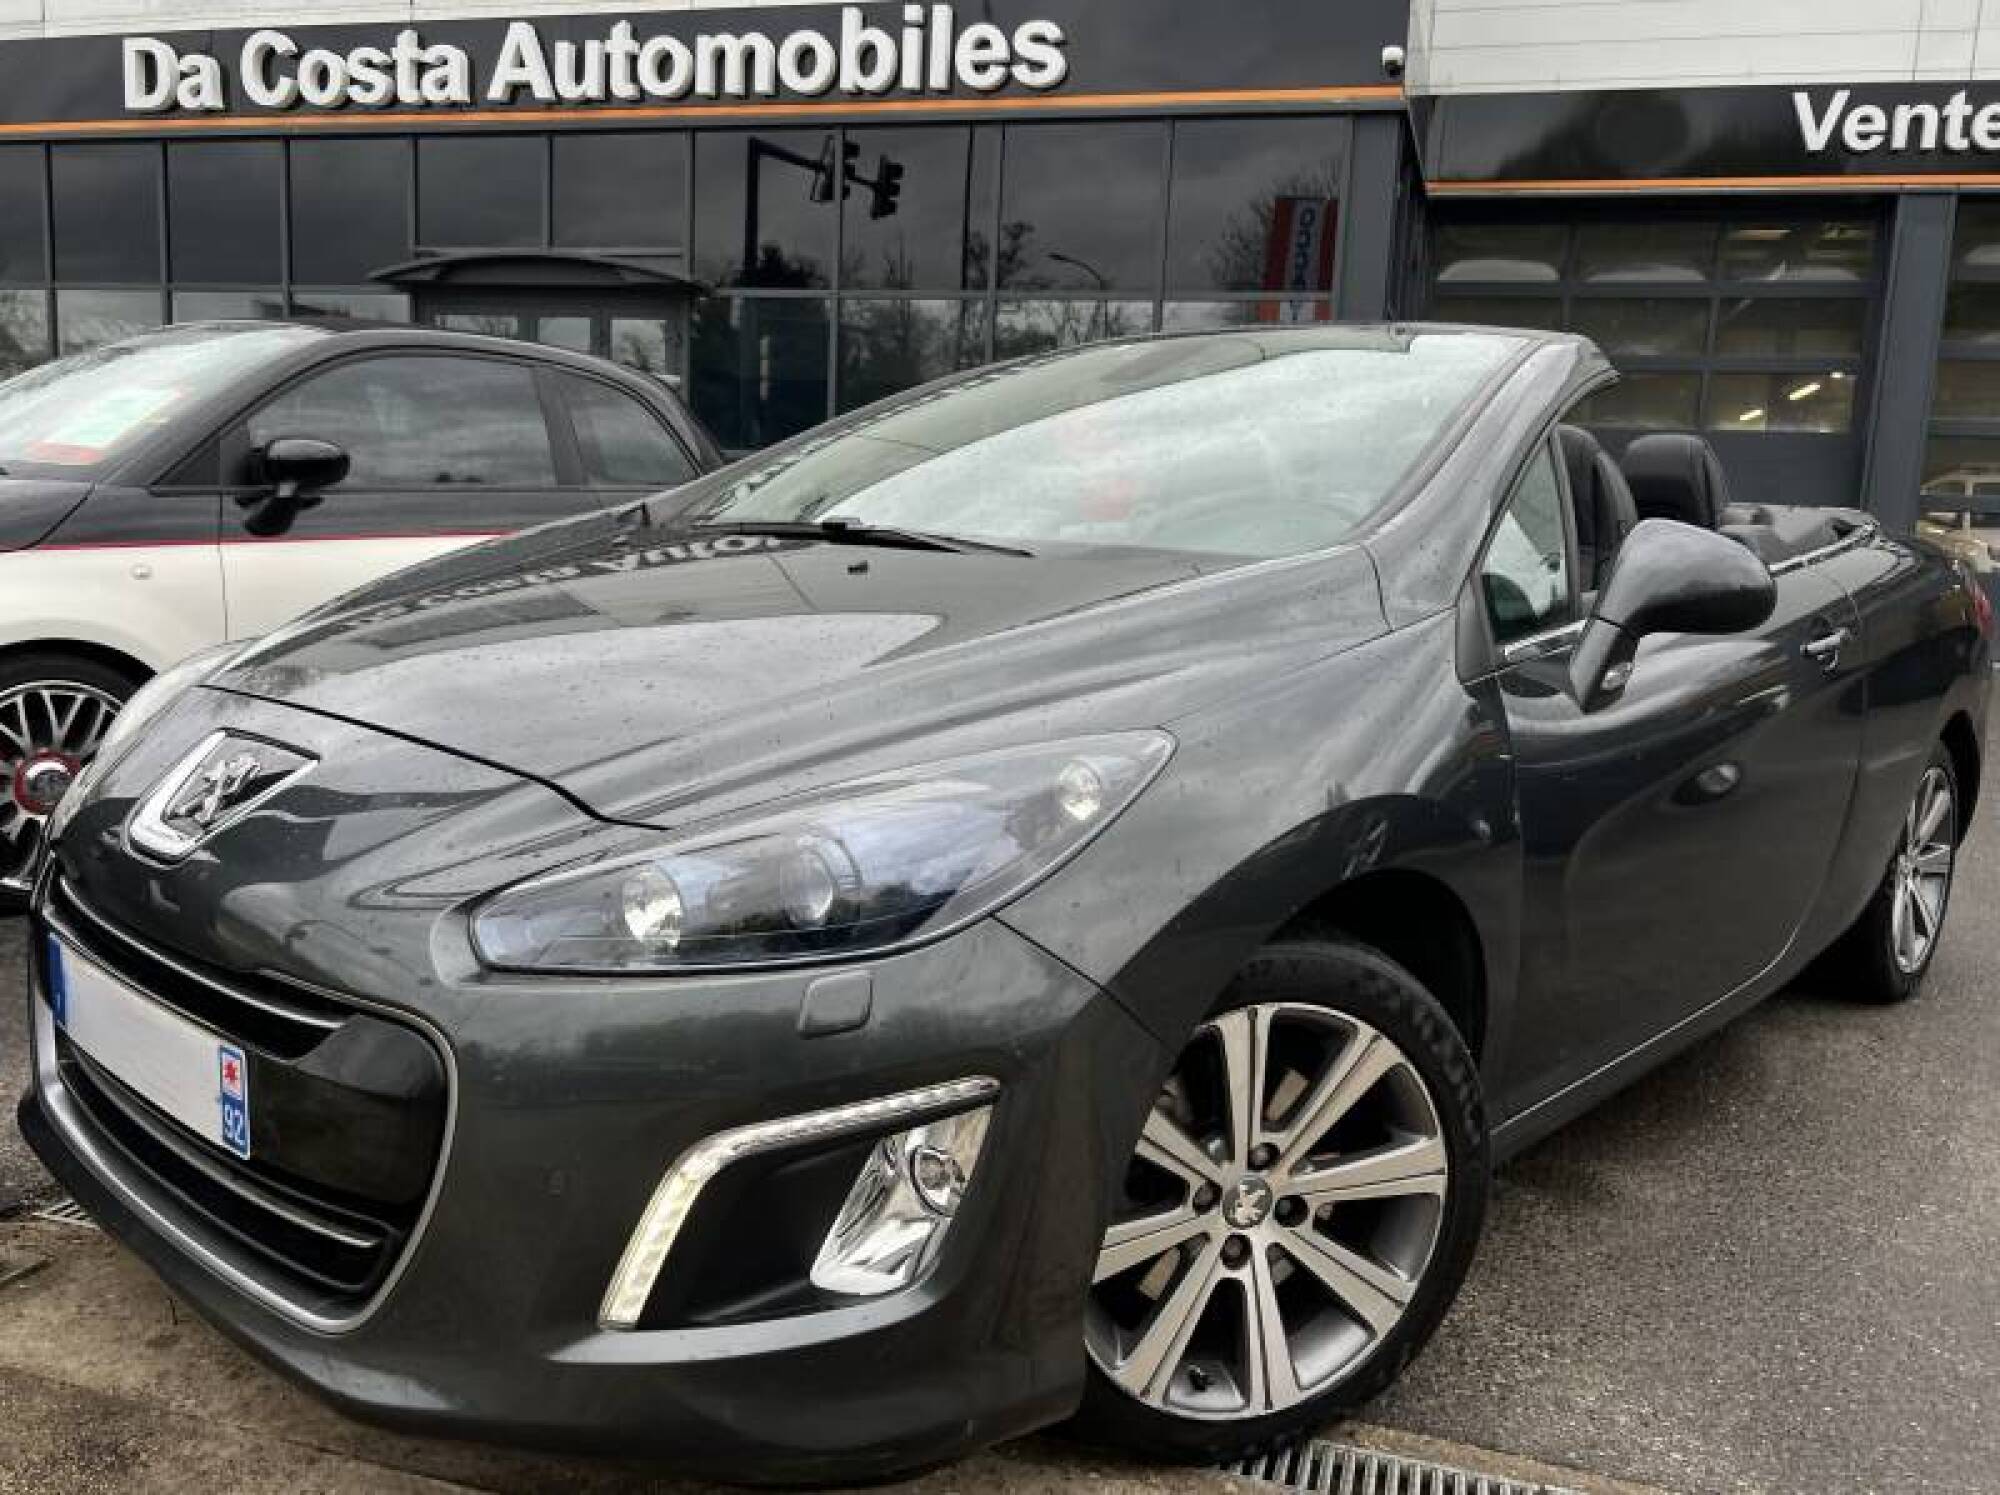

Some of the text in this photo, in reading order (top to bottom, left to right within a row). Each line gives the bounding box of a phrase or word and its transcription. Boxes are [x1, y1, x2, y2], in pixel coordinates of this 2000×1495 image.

[122, 3, 1068, 111] Da Costa Automobiles
[1793, 89, 2000, 151] Vente
[224, 1103, 246, 1146] 92
